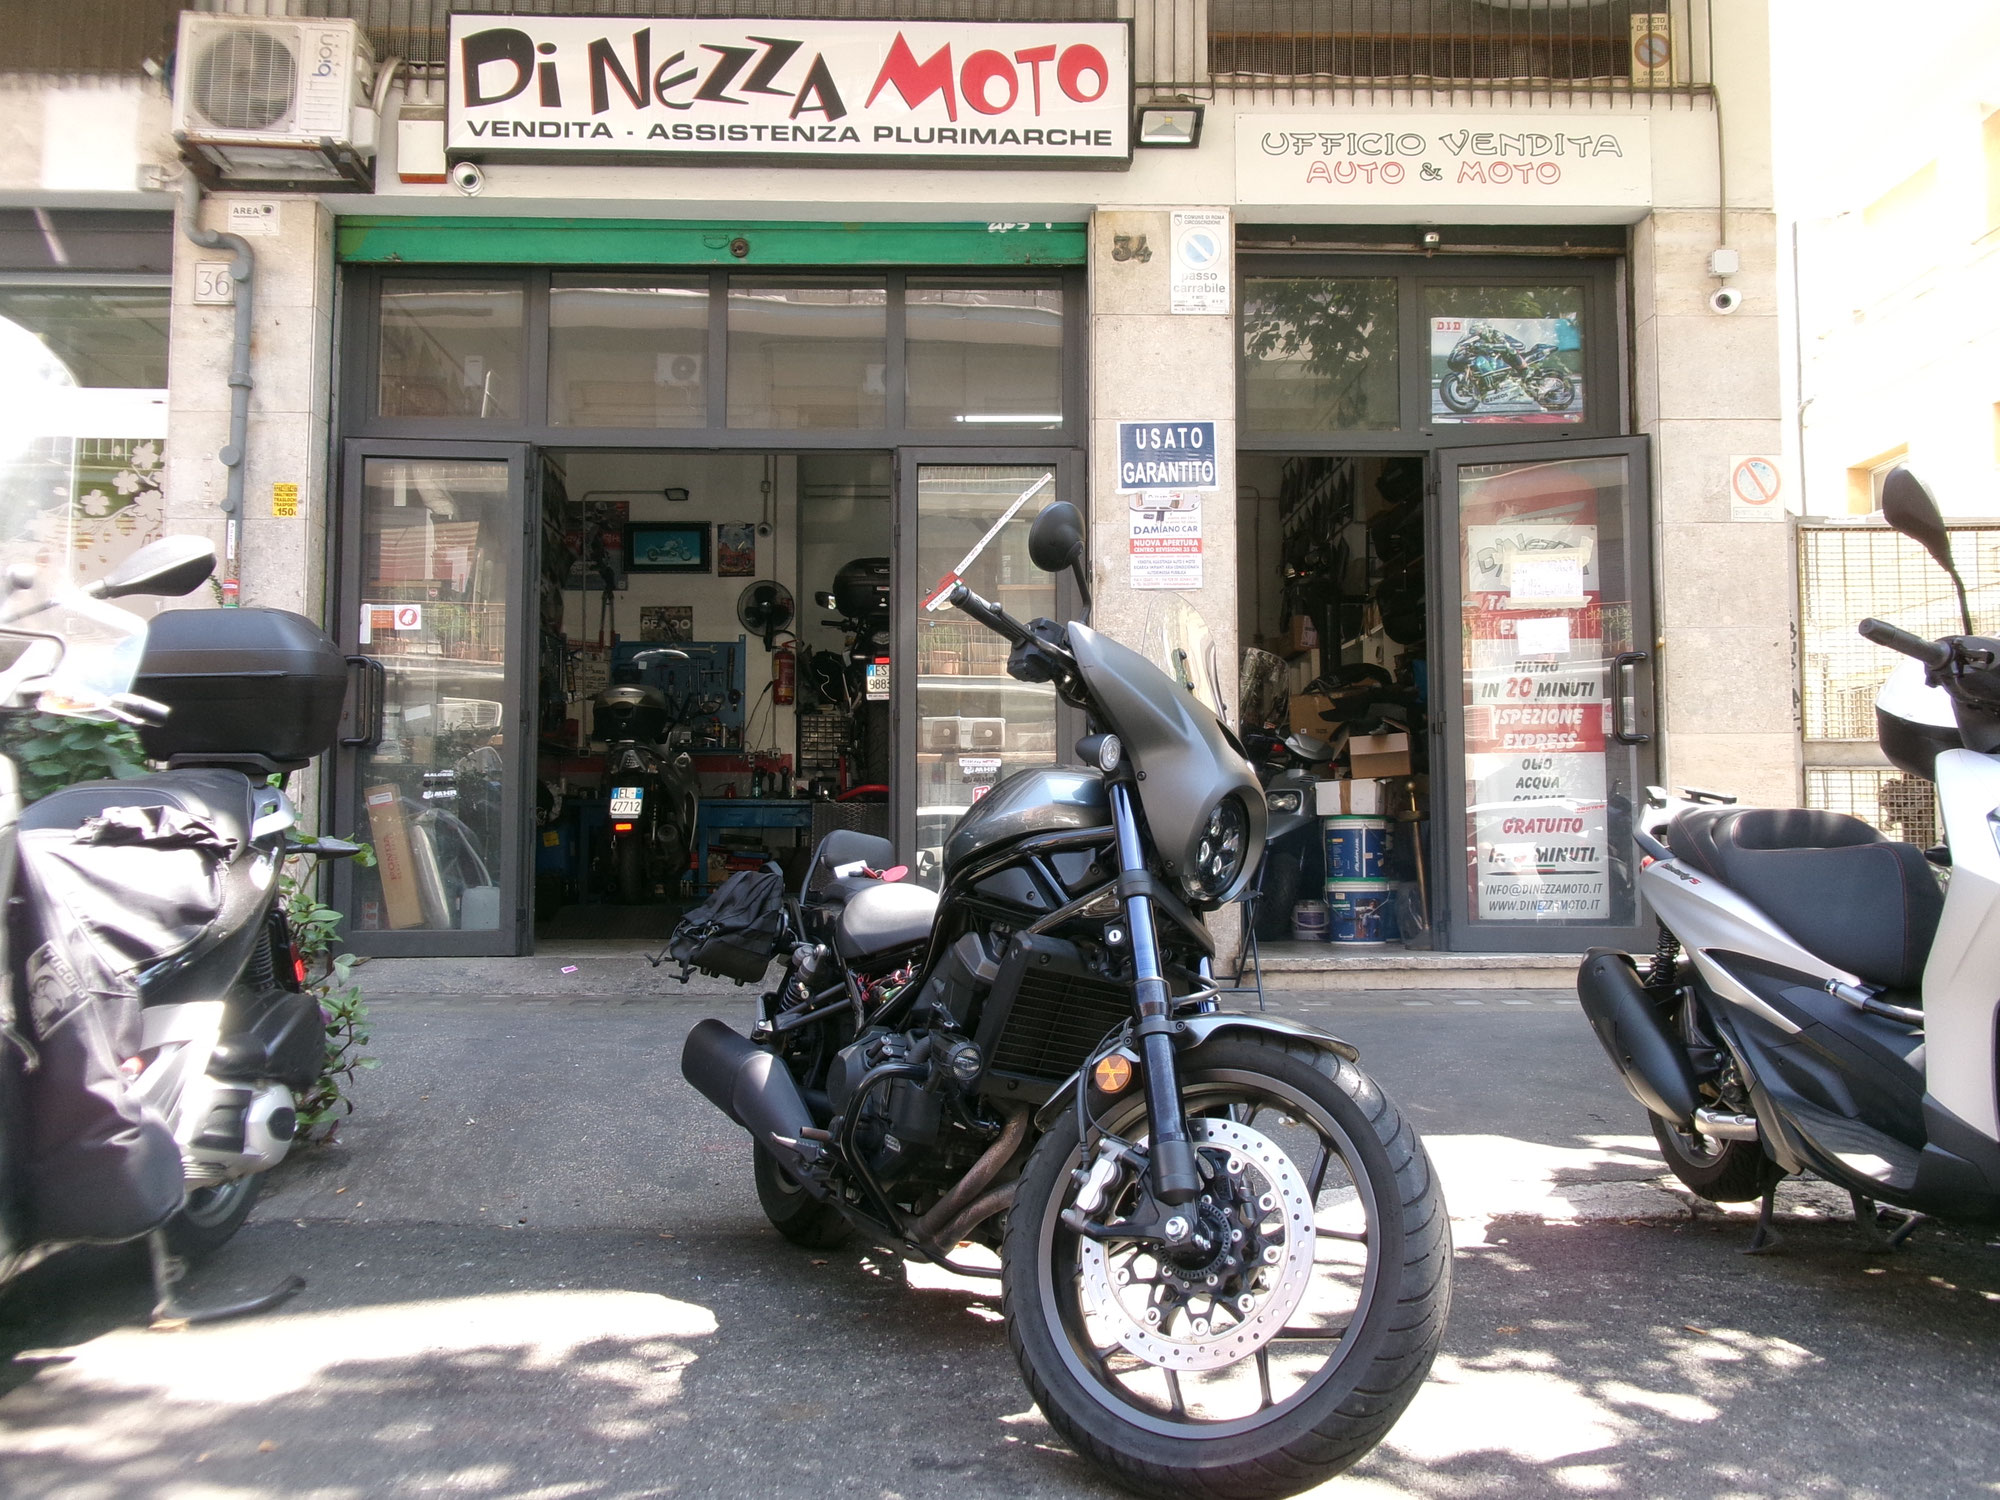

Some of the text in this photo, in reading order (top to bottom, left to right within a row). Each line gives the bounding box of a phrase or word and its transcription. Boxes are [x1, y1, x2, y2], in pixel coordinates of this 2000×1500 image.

[864, 30, 1109, 122] MOTO
[467, 120, 613, 138] VENDITA
[647, 122, 860, 143] ASSISTENZA
[874, 126, 1112, 146] PLURIMARCHE
[1261, 129, 1623, 158] UFFICIO VENDITA
[1306, 160, 1562, 185] AUTO & MOTO
[233, 207, 259, 215] AREA
[198, 270, 231, 296] 36
[1182, 272, 1218, 282] passo
[1174, 283, 1226, 292] carrabile
[1136, 427, 1203, 449] USATO
[1123, 461, 1213, 483] GARANTITO
[1134, 526, 1180, 534] DAMIANO
[876, 666, 887, 676] ES
[1514, 661, 1559, 673] FILTRO
[1481, 677, 1595, 698] IN 20 MINUTI
[1503, 733, 1578, 749] EXPRESS
[1522, 758, 1552, 770] OLIO
[1516, 777, 1560, 789] ACQUA
[620, 789, 630, 798] EL
[612, 801, 640, 812] 47712
[1503, 818, 1583, 834] GRATUITO
[1485, 884, 1603, 896] INFO@DINEZZAMOTO.IT
[1489, 900, 1600, 911] WWW.DINEZZAMOTO.IT
